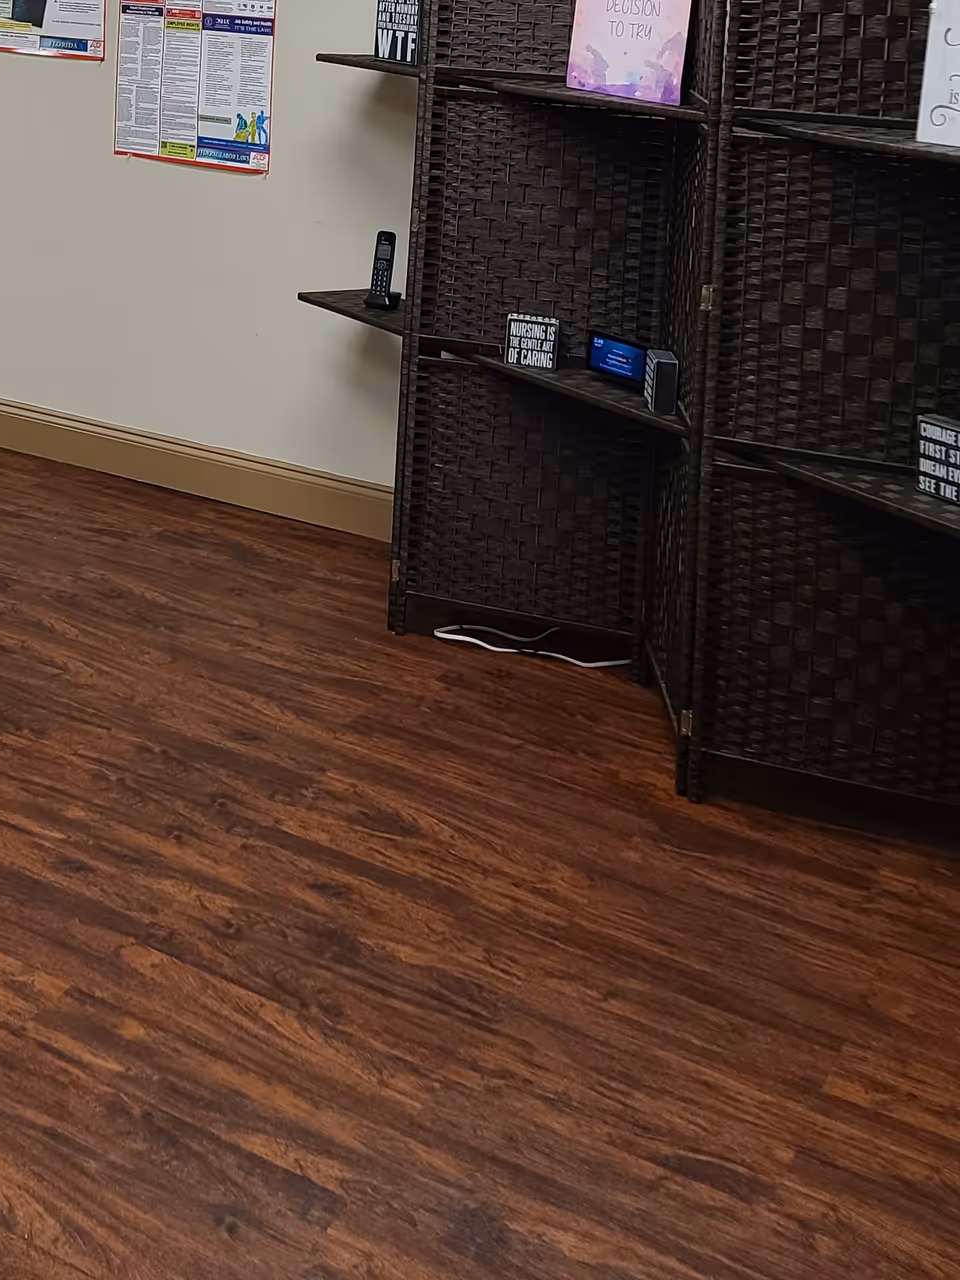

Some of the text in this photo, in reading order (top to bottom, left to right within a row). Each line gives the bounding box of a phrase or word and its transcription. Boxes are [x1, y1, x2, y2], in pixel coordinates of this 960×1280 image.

[378, 12, 418, 25] AND TUESDAY
[379, 2, 418, 15] AFTER MONDAY
[608, 21, 652, 40] TO TRY
[48, 41, 78, 49] FLORIDA
[378, 29, 416, 62] WTF
[948, 89, 959, 104] is
[510, 321, 555, 341] NURSING IS
[510, 336, 554, 353] THE GENTLE ART
[508, 348, 552, 369] OF CARING
[921, 422, 957, 446] COURAGE
[920, 440, 946, 461] FIRST
[920, 458, 947, 479] DREAM
[919, 475, 958, 500] SEE THE
